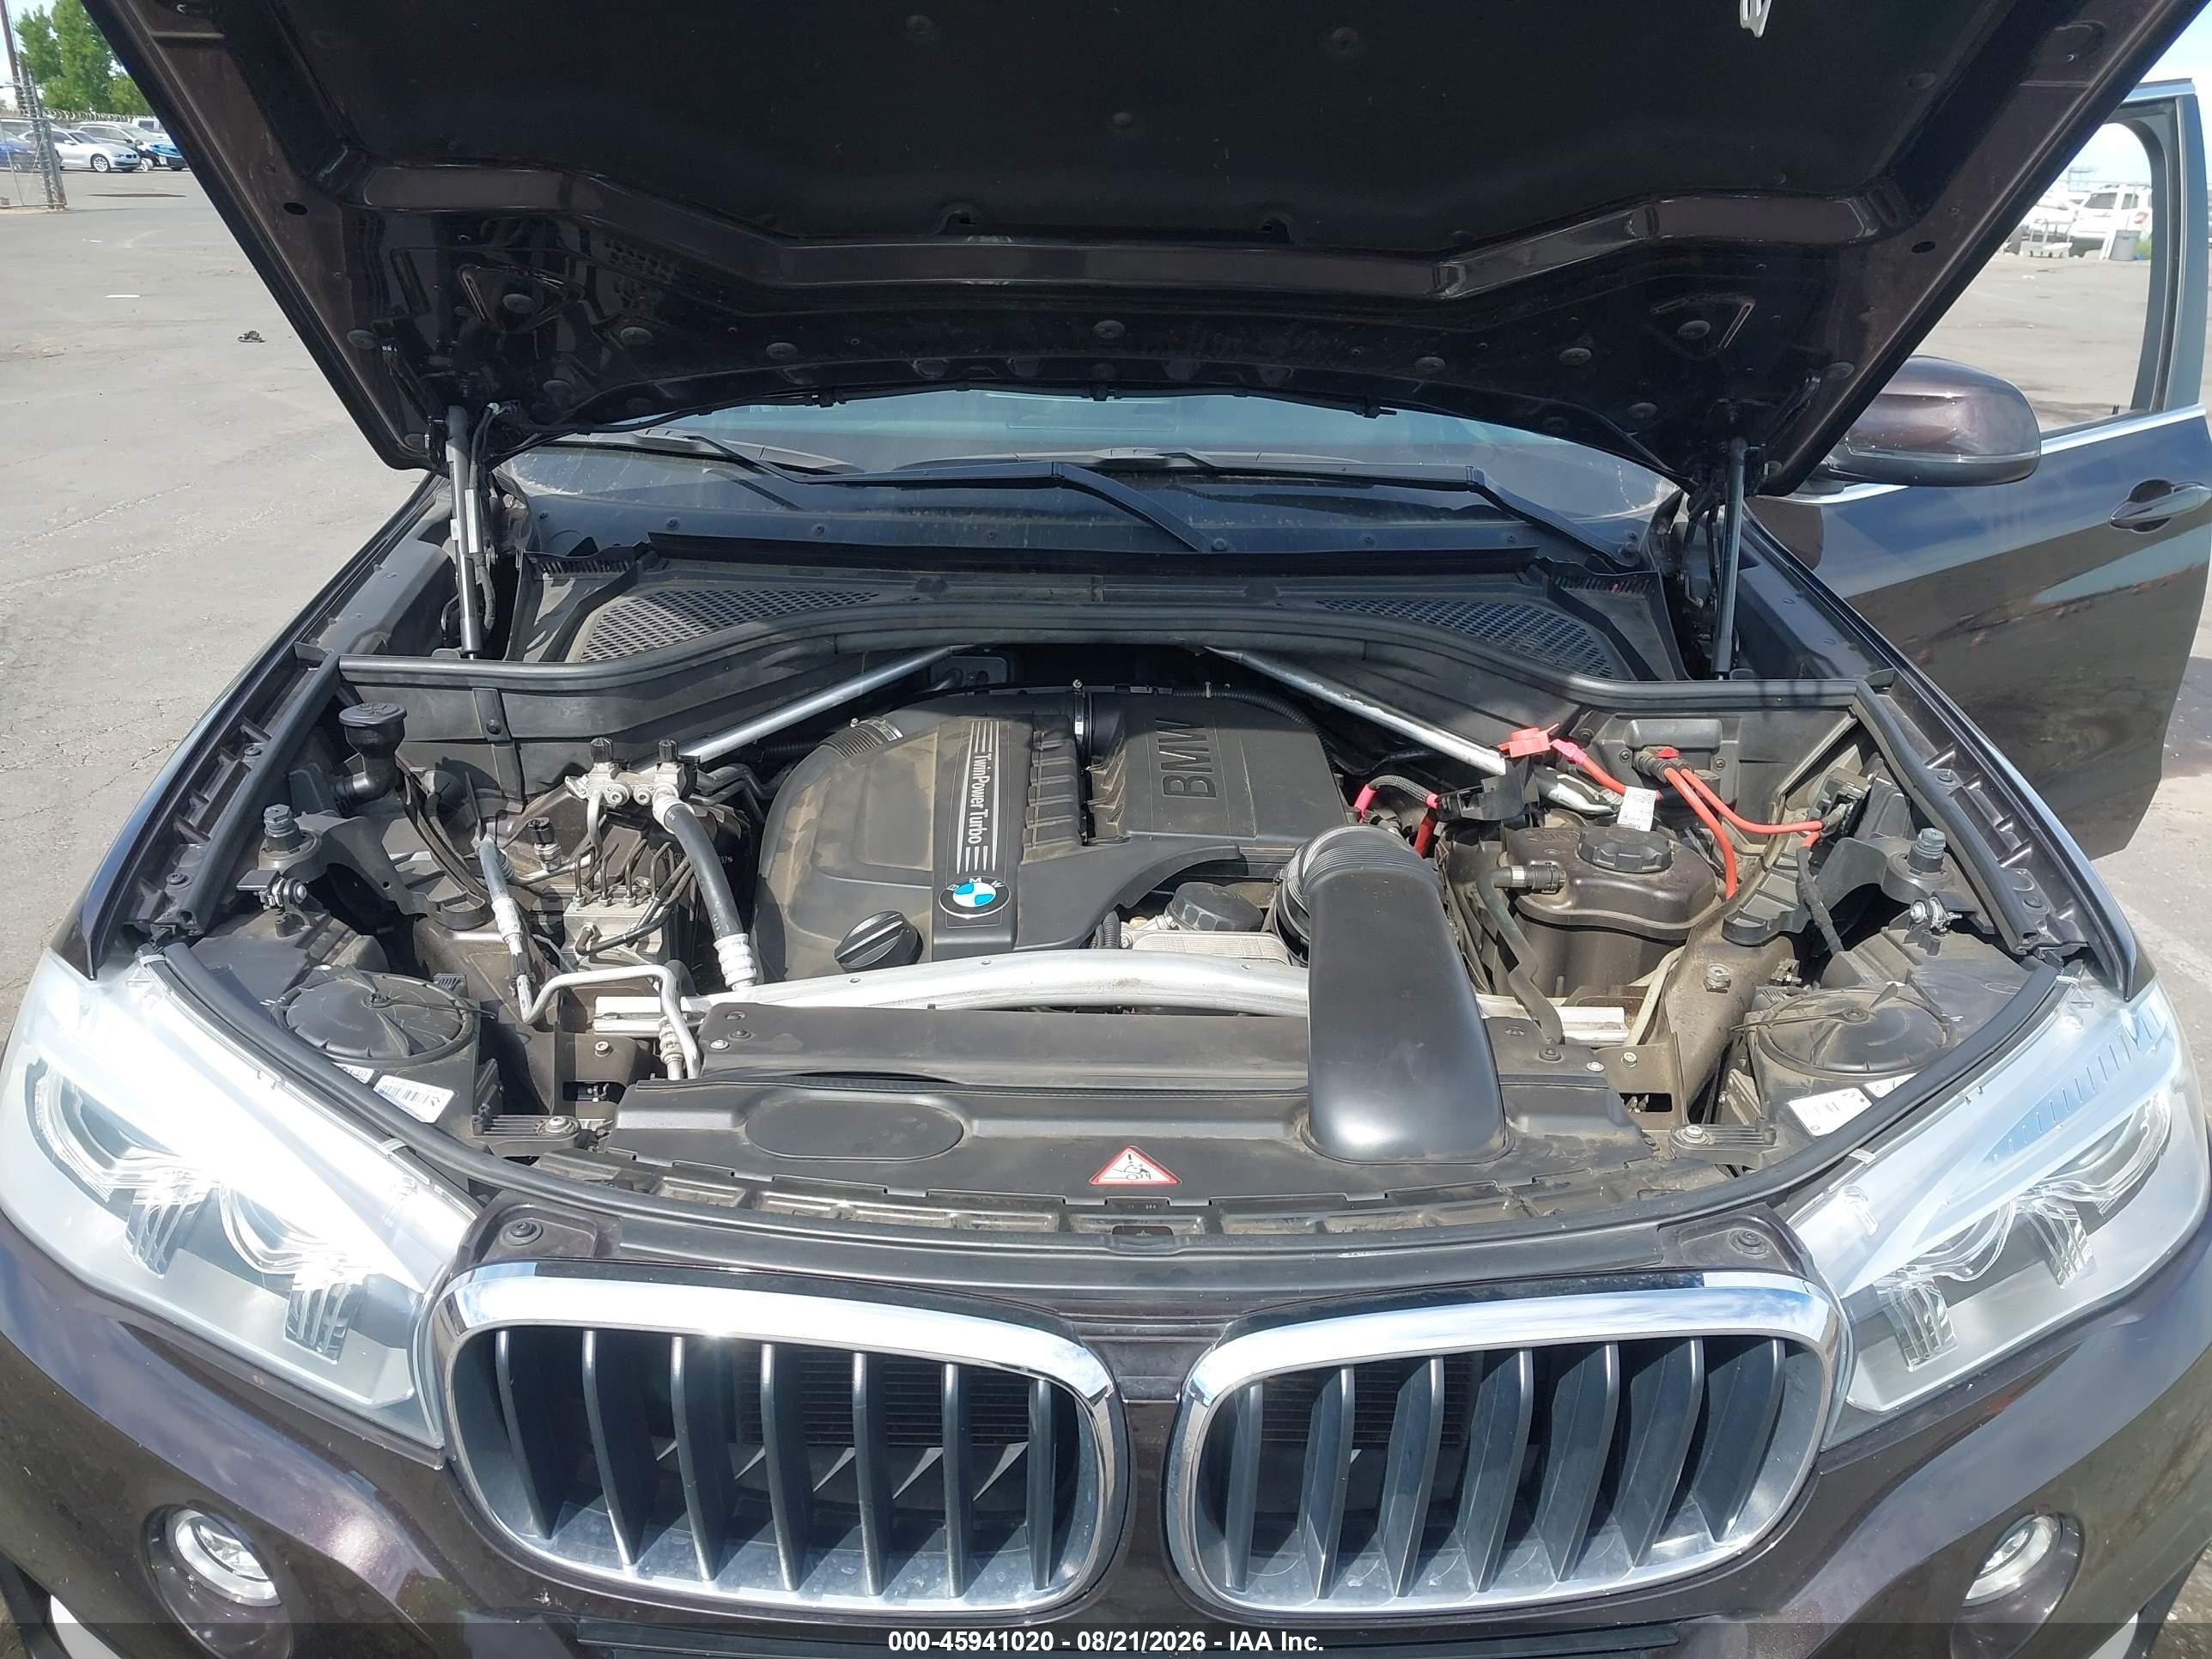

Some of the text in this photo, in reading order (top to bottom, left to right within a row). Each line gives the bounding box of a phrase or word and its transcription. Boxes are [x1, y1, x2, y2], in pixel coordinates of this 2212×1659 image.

[968, 753, 993, 845] TwinPower Turbo
[1155, 719, 1217, 799] BMW
